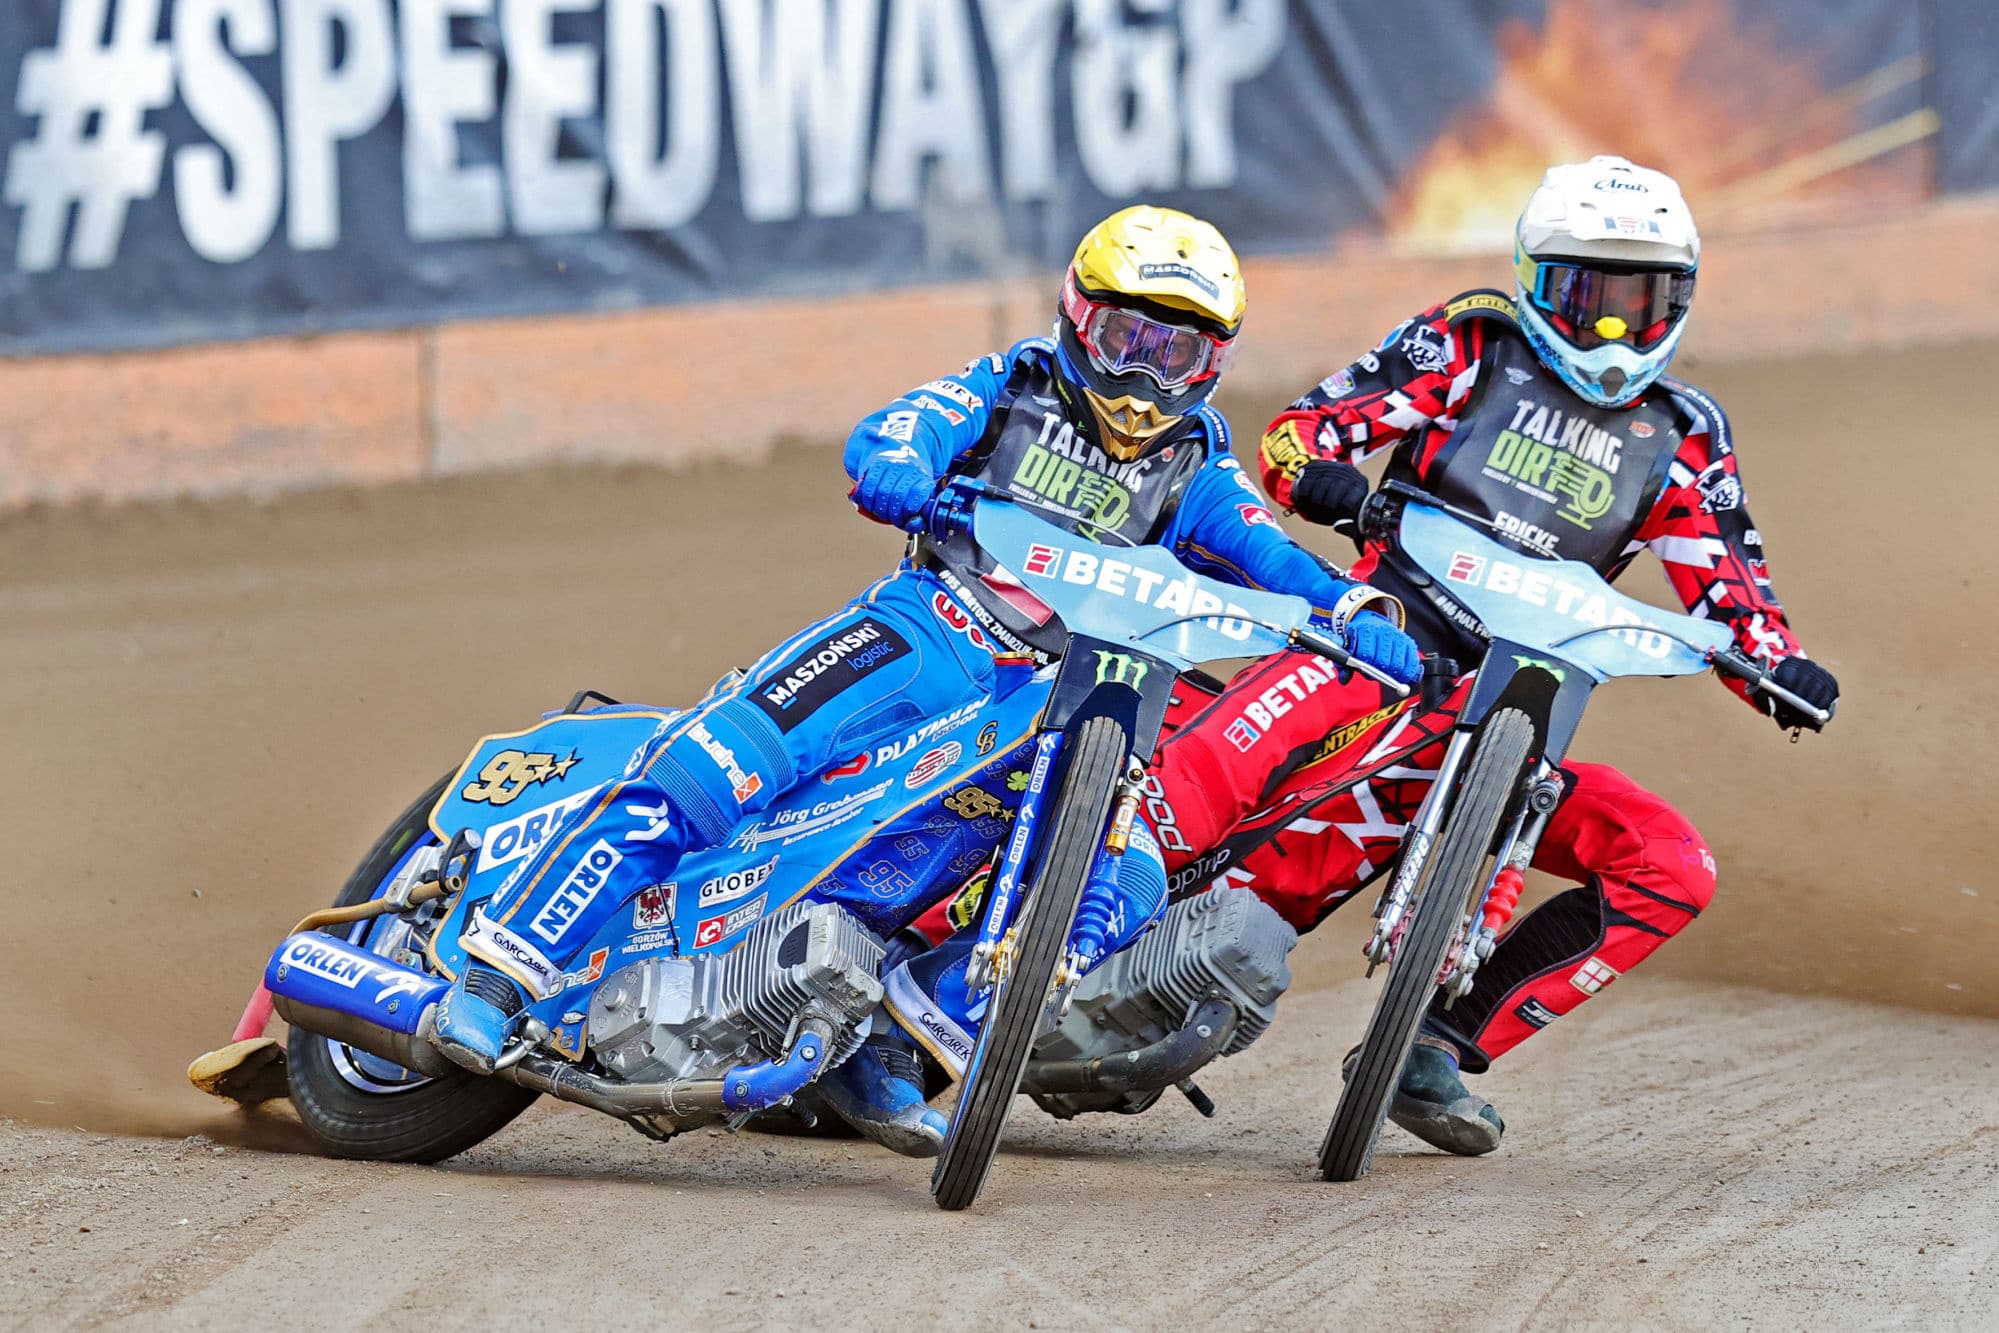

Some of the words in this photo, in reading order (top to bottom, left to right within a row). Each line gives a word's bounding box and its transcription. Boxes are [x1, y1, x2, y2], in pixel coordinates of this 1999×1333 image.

[3, 0, 1287, 273] #SPEEDWAYGP
[1506, 398, 1625, 475] TALKING
[1062, 550, 1254, 642] BETARD
[1484, 560, 1674, 659] BETARD
[766, 623, 882, 706] MASZOŃSKI
[846, 640, 894, 672] logistic
[1243, 654, 1338, 733] BETAR
[463, 750, 556, 806] 95
[1032, 757, 1048, 792] ORLEN
[769, 808, 810, 827] Jörg
[943, 786, 1002, 819] 95
[490, 804, 566, 860] ORL
[1011, 828, 1027, 862] ORLEN
[538, 848, 614, 937] ORLEN
[858, 859, 916, 899] 95
[1167, 848, 1231, 895] apTrip
[727, 900, 762, 924] INTER
[290, 941, 366, 984] ORLEN
[632, 931, 669, 945] GORZÓW
[918, 1011, 974, 1062] GARCAREK
